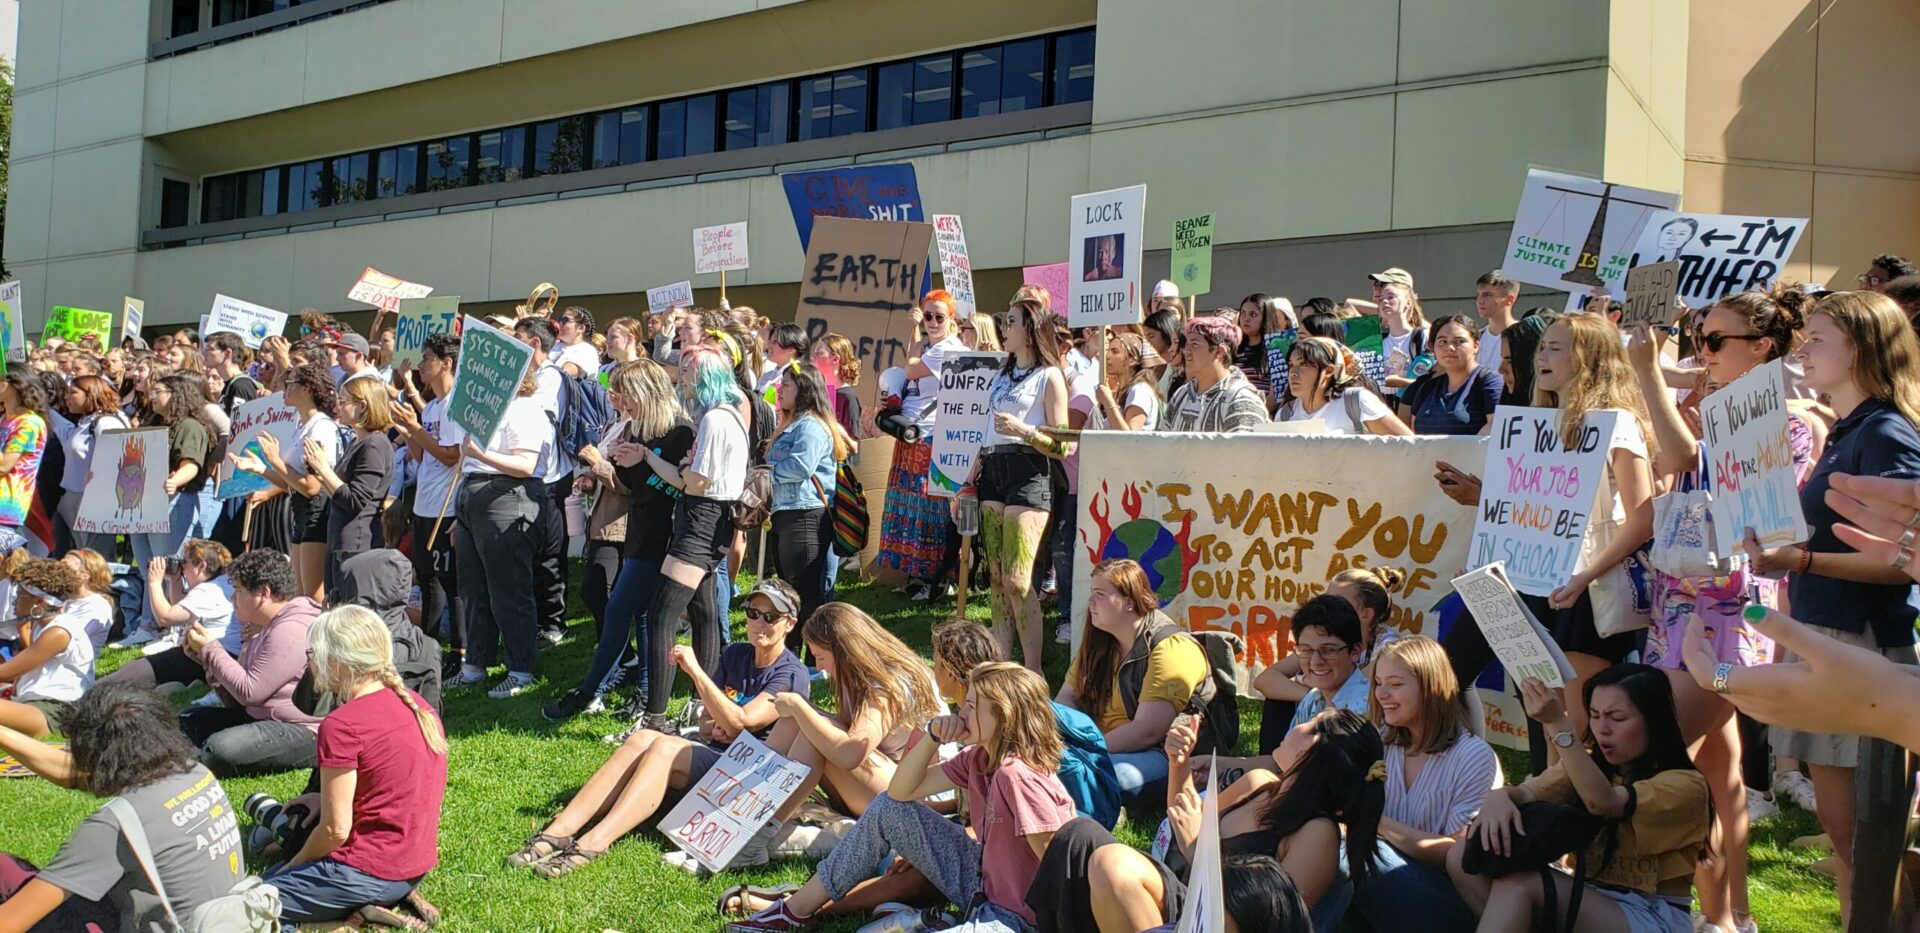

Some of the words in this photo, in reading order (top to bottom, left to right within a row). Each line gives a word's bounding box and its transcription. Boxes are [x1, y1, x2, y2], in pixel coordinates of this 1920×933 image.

[1086, 201, 1123, 224] LOCK
[1175, 215, 1210, 232] BEANZ
[702, 226, 732, 242] People
[1175, 231, 1196, 241] NEED
[1175, 235, 1210, 251] OXYGEN
[1517, 235, 1571, 256] CLIMATE
[1726, 218, 1797, 259] I'M
[702, 242, 732, 256] Before
[1514, 249, 1566, 270] JUSTICE
[1578, 252, 1599, 268] IS
[810, 253, 917, 300] EARTH
[1598, 267, 1623, 280] JUS
[372, 293, 398, 309] DYI
[651, 291, 667, 307] ACT
[668, 287, 689, 301] NOW
[1080, 294, 1104, 313] HIM
[1108, 292, 1125, 311] UP
[73, 311, 109, 332] LOVE
[220, 313, 237, 321] STAND
[223, 303, 240, 312] STAND
[240, 308, 255, 316] WITH
[255, 312, 275, 321] SCIENCE
[217, 322, 246, 333] HUMANITY
[395, 313, 455, 353] PROTECT
[469, 333, 517, 370] SYSTEM
[805, 317, 909, 372] PFIT
[466, 358, 499, 387] CHANGE
[498, 379, 514, 392] NOT
[944, 374, 992, 391] UNFRA
[465, 379, 504, 415] CLIMATE
[463, 404, 490, 436] CHANGE
[942, 402, 964, 415] THE
[970, 403, 991, 416] PLA
[228, 412, 253, 445] Sink
[255, 412, 265, 425] or
[945, 429, 983, 443] WATER
[1500, 416, 1524, 450] IF
[1705, 405, 1719, 448] IF
[939, 453, 970, 467] WITH
[646, 473, 668, 491] WE
[1506, 453, 1543, 494] YOUR
[1543, 464, 1580, 498] JOB
[1726, 488, 1758, 539] WE
[1758, 475, 1794, 533] WILL
[1205, 482, 1338, 538] WANT
[1336, 497, 1448, 564] YOU
[1483, 499, 1512, 524] WE
[1511, 501, 1553, 533] WOULD
[1553, 509, 1586, 540] BE
[432, 549, 450, 572] 21
[1191, 534, 1233, 565] TO
[1240, 536, 1314, 575] ACT
[1326, 552, 1368, 583] AS
[1473, 532, 1496, 569] IN
[1503, 538, 1574, 585] SCHOOL!
[1191, 568, 1257, 601] OUR
[1264, 576, 1326, 603] HOUS
[1480, 597, 1518, 624] GROW
[1516, 640, 1540, 657] BE
[728, 741, 754, 765] OUR
[778, 772, 802, 794] BE
[172, 796, 210, 827] GOOD
[195, 834, 209, 850] A
[208, 829, 240, 860] FUTU
